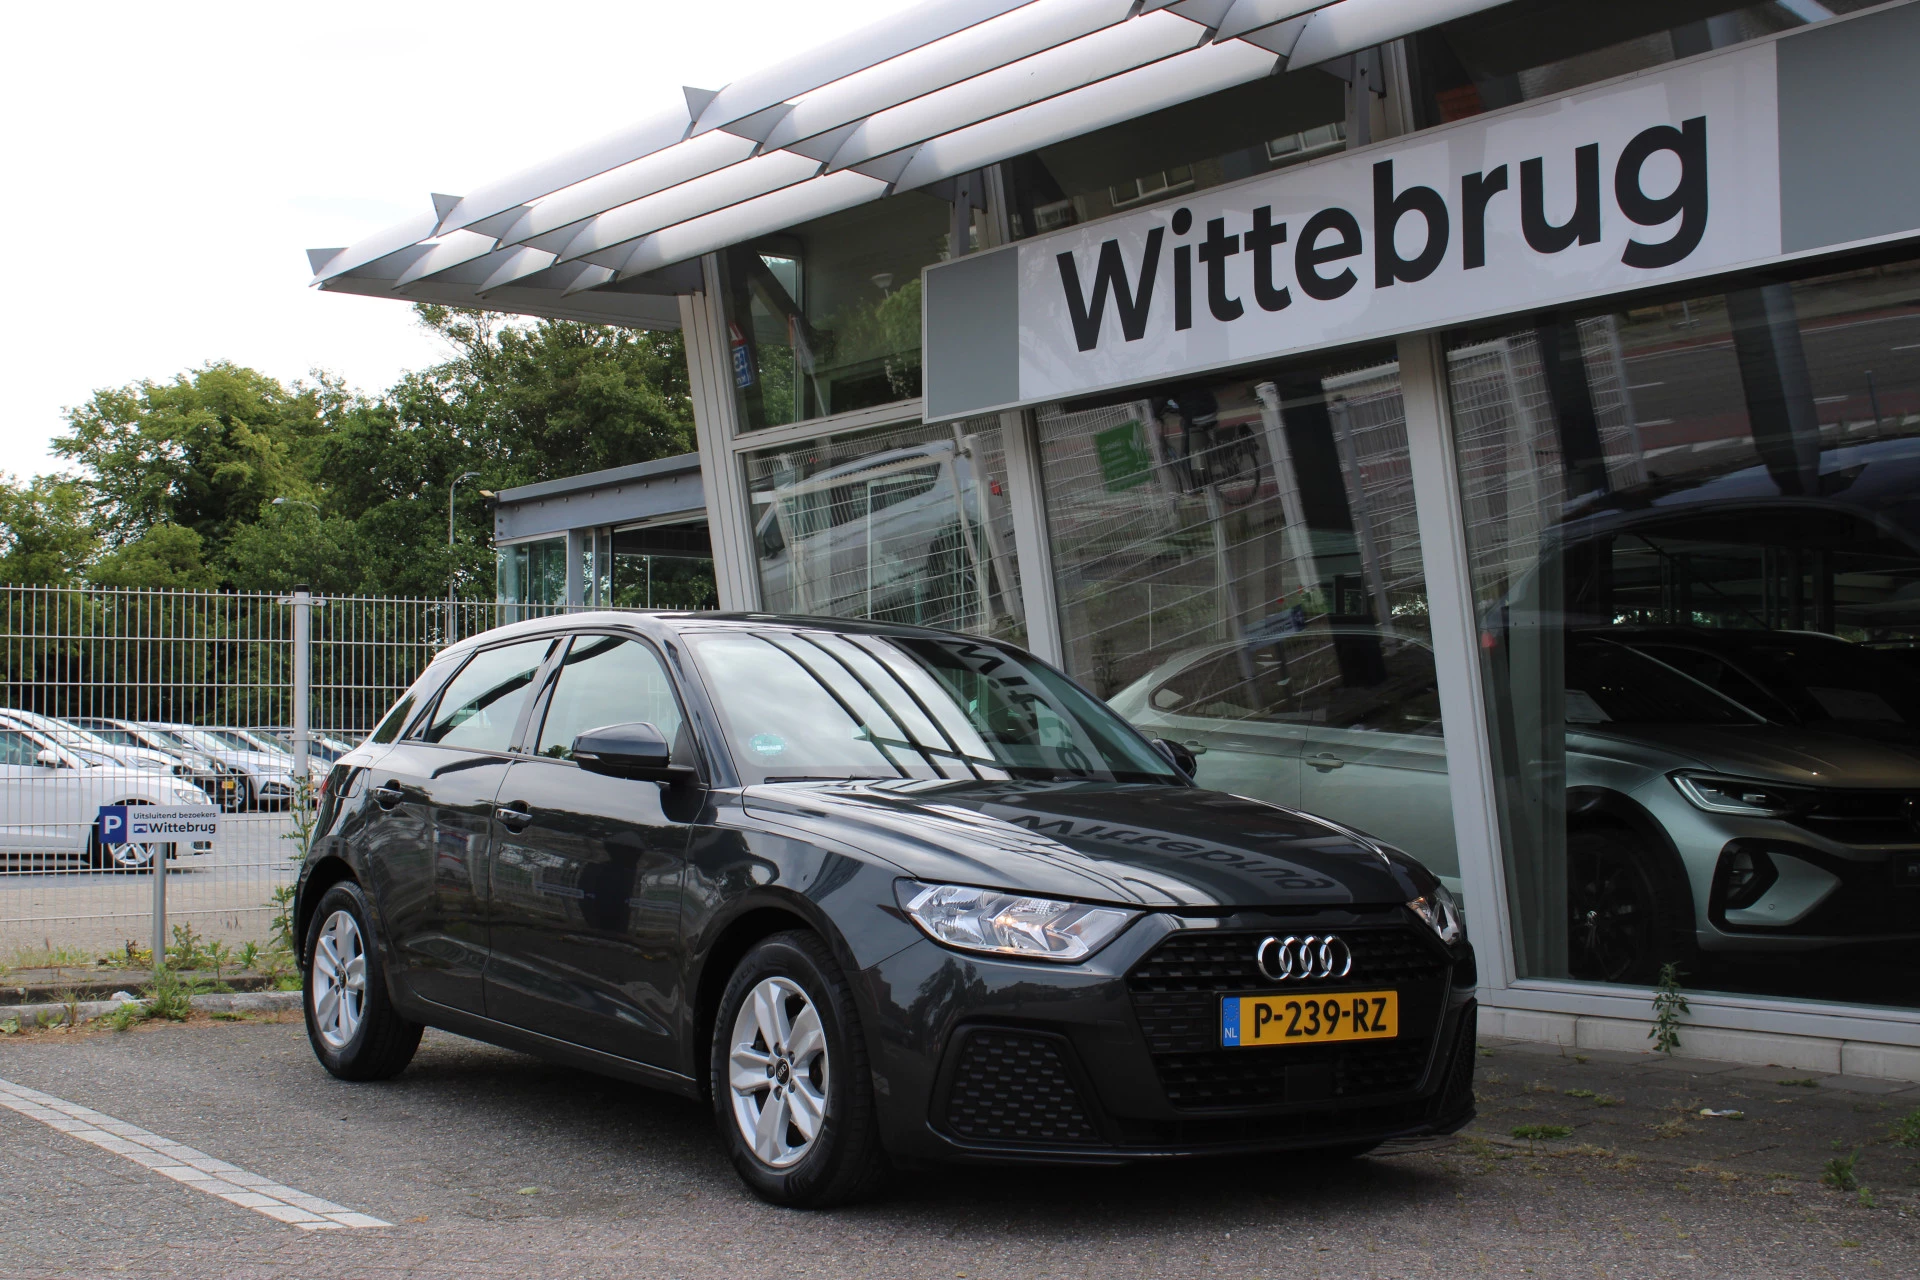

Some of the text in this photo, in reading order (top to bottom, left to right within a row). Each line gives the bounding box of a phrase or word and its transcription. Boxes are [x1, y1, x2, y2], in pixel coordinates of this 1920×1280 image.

[1056, 114, 1708, 352] Wittebrug
[104, 815, 122, 834] P
[133, 811, 217, 820] Uitsluitend bezoekers
[149, 822, 216, 835] Wittebrug
[1224, 997, 1387, 1039] NL P-239-RZ
